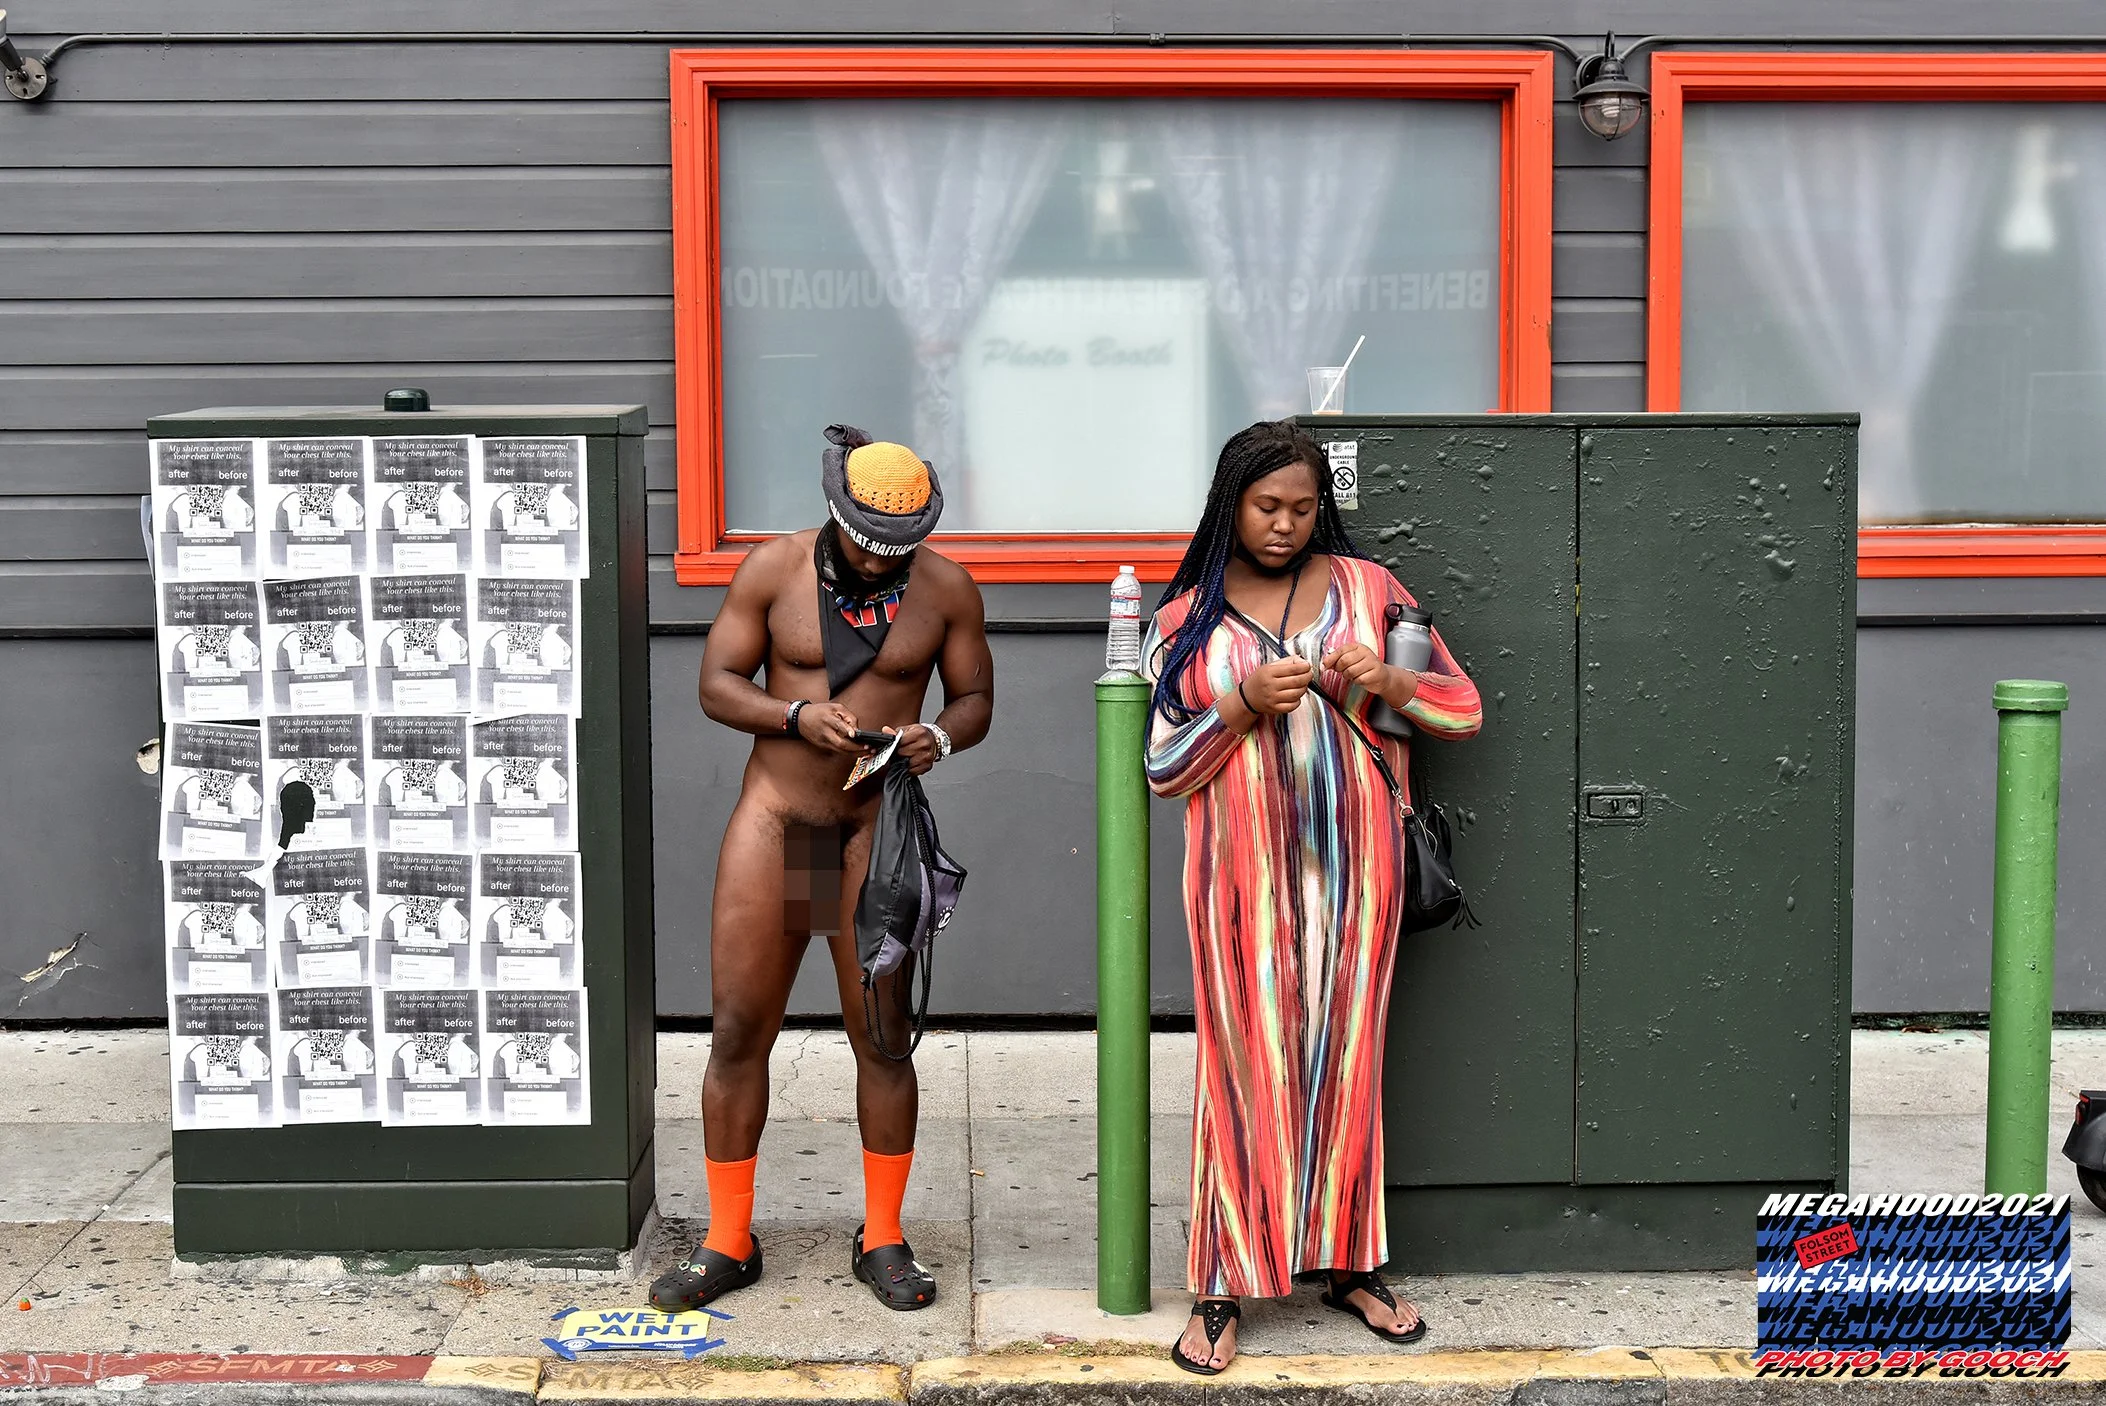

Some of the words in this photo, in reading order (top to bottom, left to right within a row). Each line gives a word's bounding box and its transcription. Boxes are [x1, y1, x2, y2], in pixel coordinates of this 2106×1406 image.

[982, 336, 1072, 367] Photo
[1086, 335, 1174, 367] Booth
[215, 444, 243, 452] conceal
[326, 443, 354, 451] conceal
[541, 443, 569, 451] conceal
[210, 452, 224, 460] like
[283, 451, 300, 459] Your
[321, 451, 335, 459] like
[498, 450, 515, 458] Your
[168, 469, 190, 478] after
[278, 468, 300, 477] after
[329, 469, 358, 478] before
[384, 466, 405, 475] after
[434, 468, 463, 477] before
[493, 467, 515, 476] after
[543, 469, 573, 478] before
[218, 471, 248, 480] before
[429, 578, 456, 586] conceal
[386, 587, 403, 595] Your
[424, 586, 438, 594] like
[276, 607, 298, 617] after
[327, 606, 356, 616] before
[382, 603, 403, 613] after
[432, 604, 461, 613] before
[487, 605, 509, 615] after
[174, 609, 195, 619] after
[224, 611, 253, 620] before
[537, 608, 567, 618] before
[429, 720, 457, 728] conceal
[283, 726, 300, 734] Your
[424, 727, 438, 735] like
[278, 743, 300, 752] after
[328, 744, 357, 753] before
[382, 743, 403, 752] after
[432, 745, 461, 755] before
[483, 741, 505, 750] after
[533, 743, 562, 752] before
[181, 750, 203, 762] after
[231, 757, 260, 768] before
[538, 858, 566, 866] conceal
[496, 864, 513, 872] Your
[283, 878, 305, 888] after
[333, 877, 362, 887] before
[386, 878, 408, 889] after
[490, 880, 512, 890] after
[181, 886, 202, 896] after
[436, 883, 466, 893] before
[540, 883, 569, 893] before
[230, 889, 259, 898] before
[441, 993, 469, 1001] conceal
[228, 1004, 241, 1012] like
[436, 1001, 450, 1009] like
[289, 1015, 310, 1024] after
[338, 1015, 367, 1024] before
[394, 1017, 416, 1026] after
[444, 1019, 473, 1028] before
[496, 1017, 517, 1026] after
[545, 1019, 574, 1028] before
[186, 1020, 207, 1029] after
[235, 1022, 264, 1030] before
[598, 1311, 683, 1324] WET
[576, 1323, 698, 1337] PAINT
[184, 1358, 357, 1377] SFMTA
